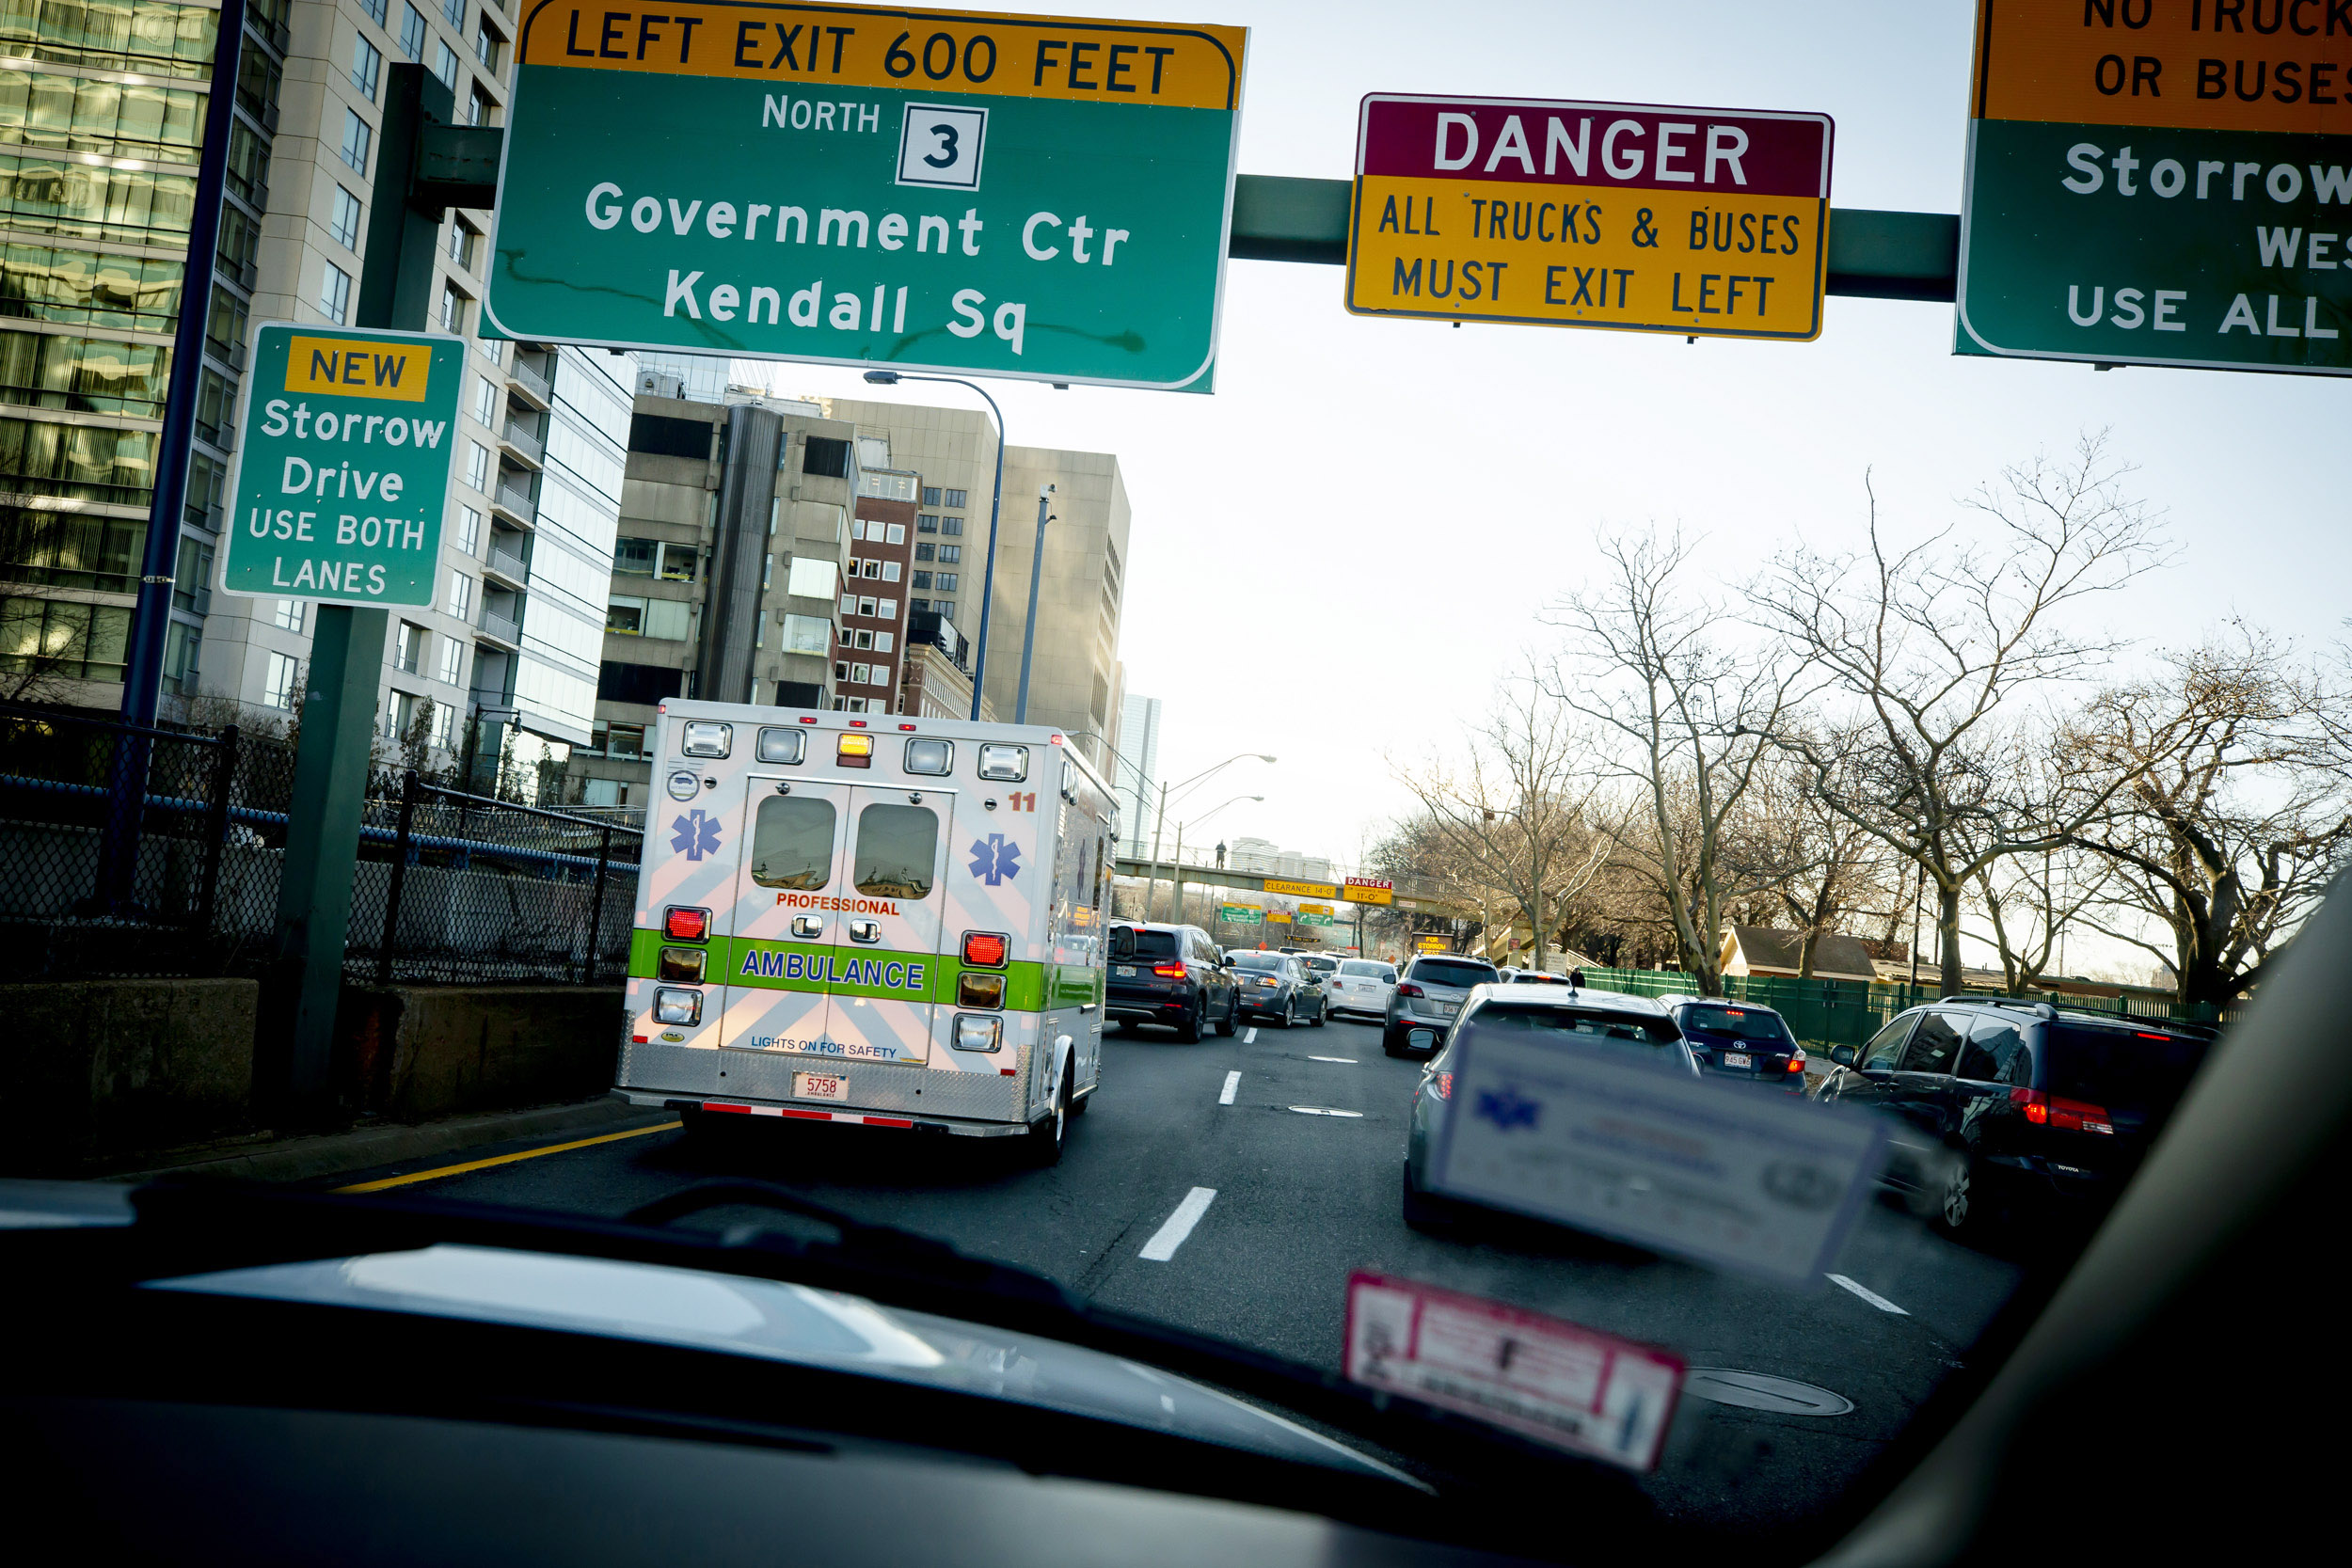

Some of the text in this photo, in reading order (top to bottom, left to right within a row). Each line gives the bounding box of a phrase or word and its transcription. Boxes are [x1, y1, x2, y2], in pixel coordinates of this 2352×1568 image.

[2084, 0, 2152, 29] NO
[565, 10, 1174, 95] LEFT EXIT 600 FEET
[2095, 55, 2352, 104] OR BUSE
[762, 94, 880, 135] NORTH
[922, 123, 959, 169] 3
[1434, 112, 1750, 185] DANGER
[2061, 143, 2352, 204] Storrow
[584, 182, 1130, 267] Government Ctr
[1378, 195, 1800, 255] ALL TRUCKS & BUSES
[1392, 257, 1774, 317] MUST EXIT LEFT
[663, 270, 1026, 356] Kendall Sq
[2068, 285, 2339, 339] USE ALL
[310, 349, 407, 388] NEW
[261, 399, 446, 449] Storrow
[280, 456, 404, 502] Drive
[249, 508, 424, 550] USE BOTH
[272, 557, 387, 595] LANES
[1009, 791, 1036, 813] 11
[776, 893, 900, 915] PROFESSIONAL
[1265, 882, 1311, 893] CLEARANCE
[1348, 878, 1390, 888] DANGER
[740, 950, 925, 989] AMBULANCE
[751, 1036, 897, 1058] LIGHTS ON FOR SAFETY
[807, 1078, 837, 1093] 5758
